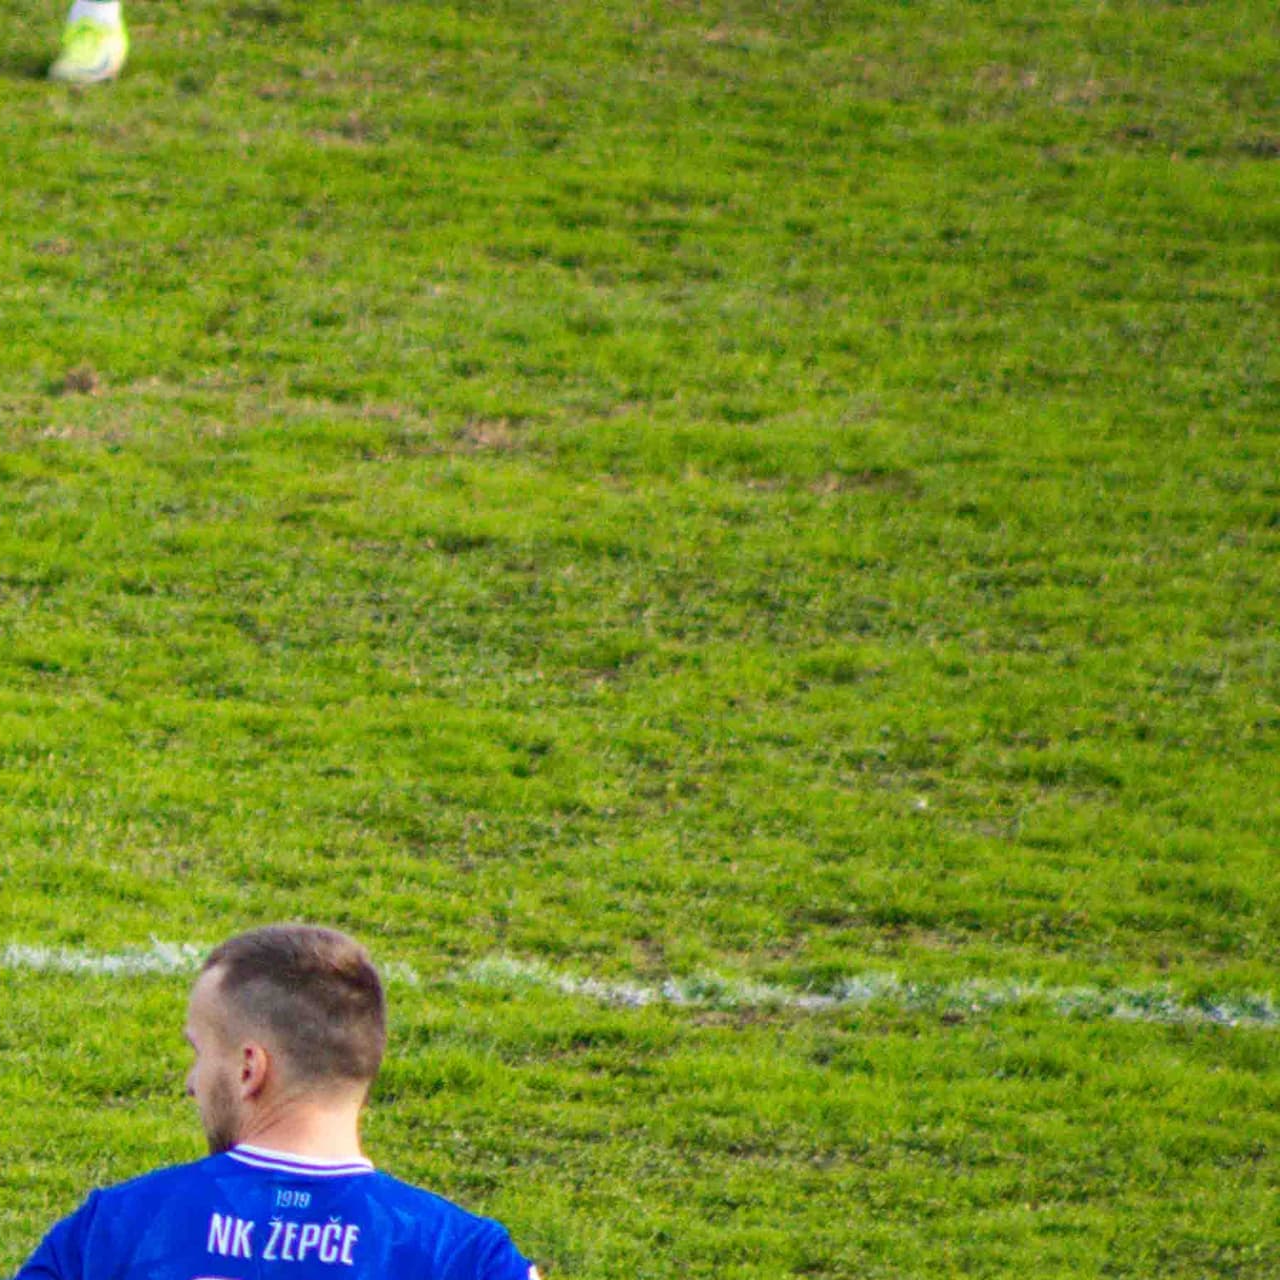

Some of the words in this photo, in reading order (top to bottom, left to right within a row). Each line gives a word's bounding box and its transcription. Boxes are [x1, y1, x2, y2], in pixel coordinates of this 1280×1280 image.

[276, 1189, 312, 1208] 1919
[207, 1212, 255, 1259] NK
[262, 1215, 361, 1266] ŽEPČE
